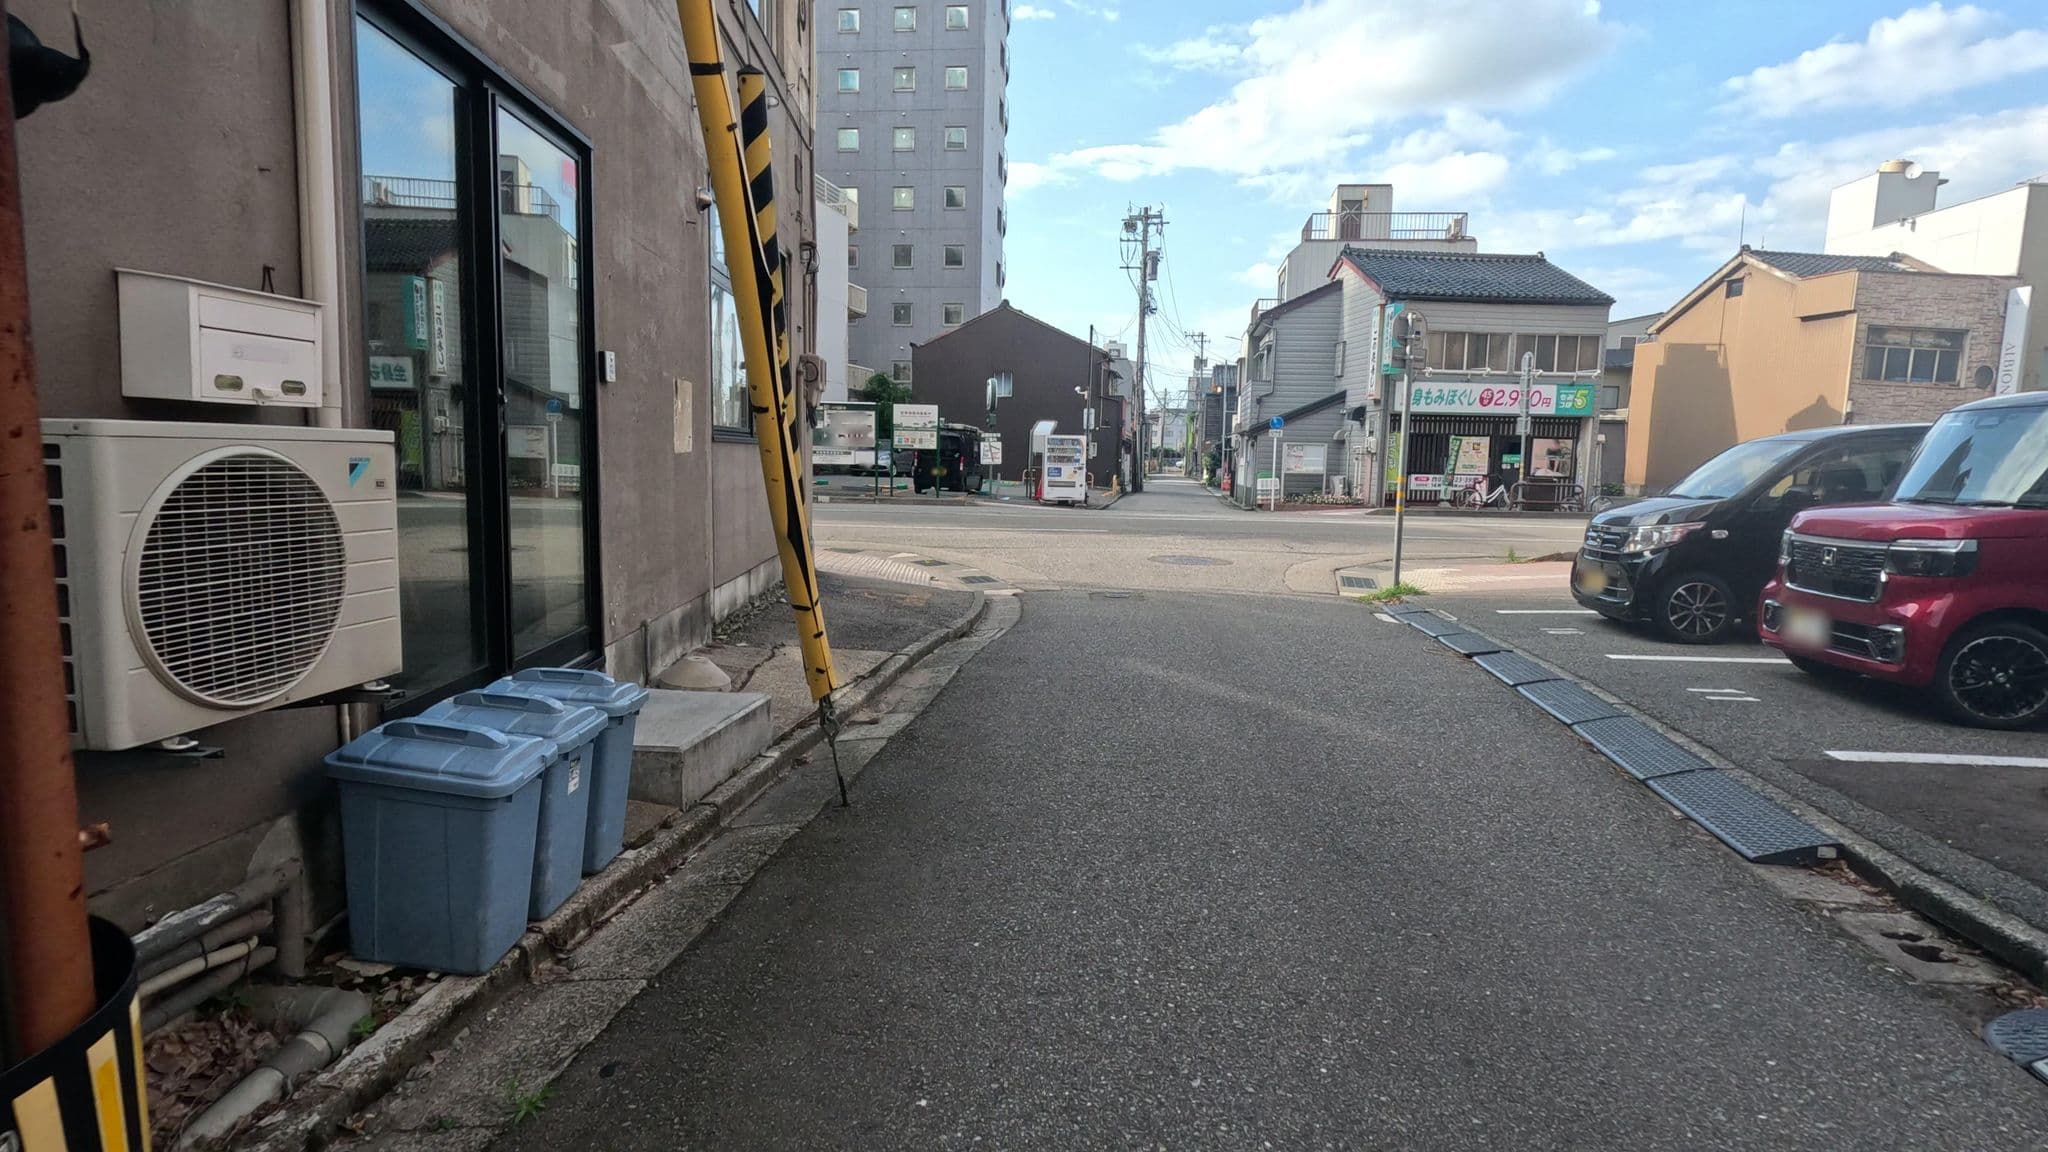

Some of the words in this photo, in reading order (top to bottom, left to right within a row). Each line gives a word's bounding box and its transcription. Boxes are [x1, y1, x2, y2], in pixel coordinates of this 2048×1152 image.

[1401, 388, 1476, 406] 身もみほぐし
[1494, 388, 1552, 407] 2,90円
